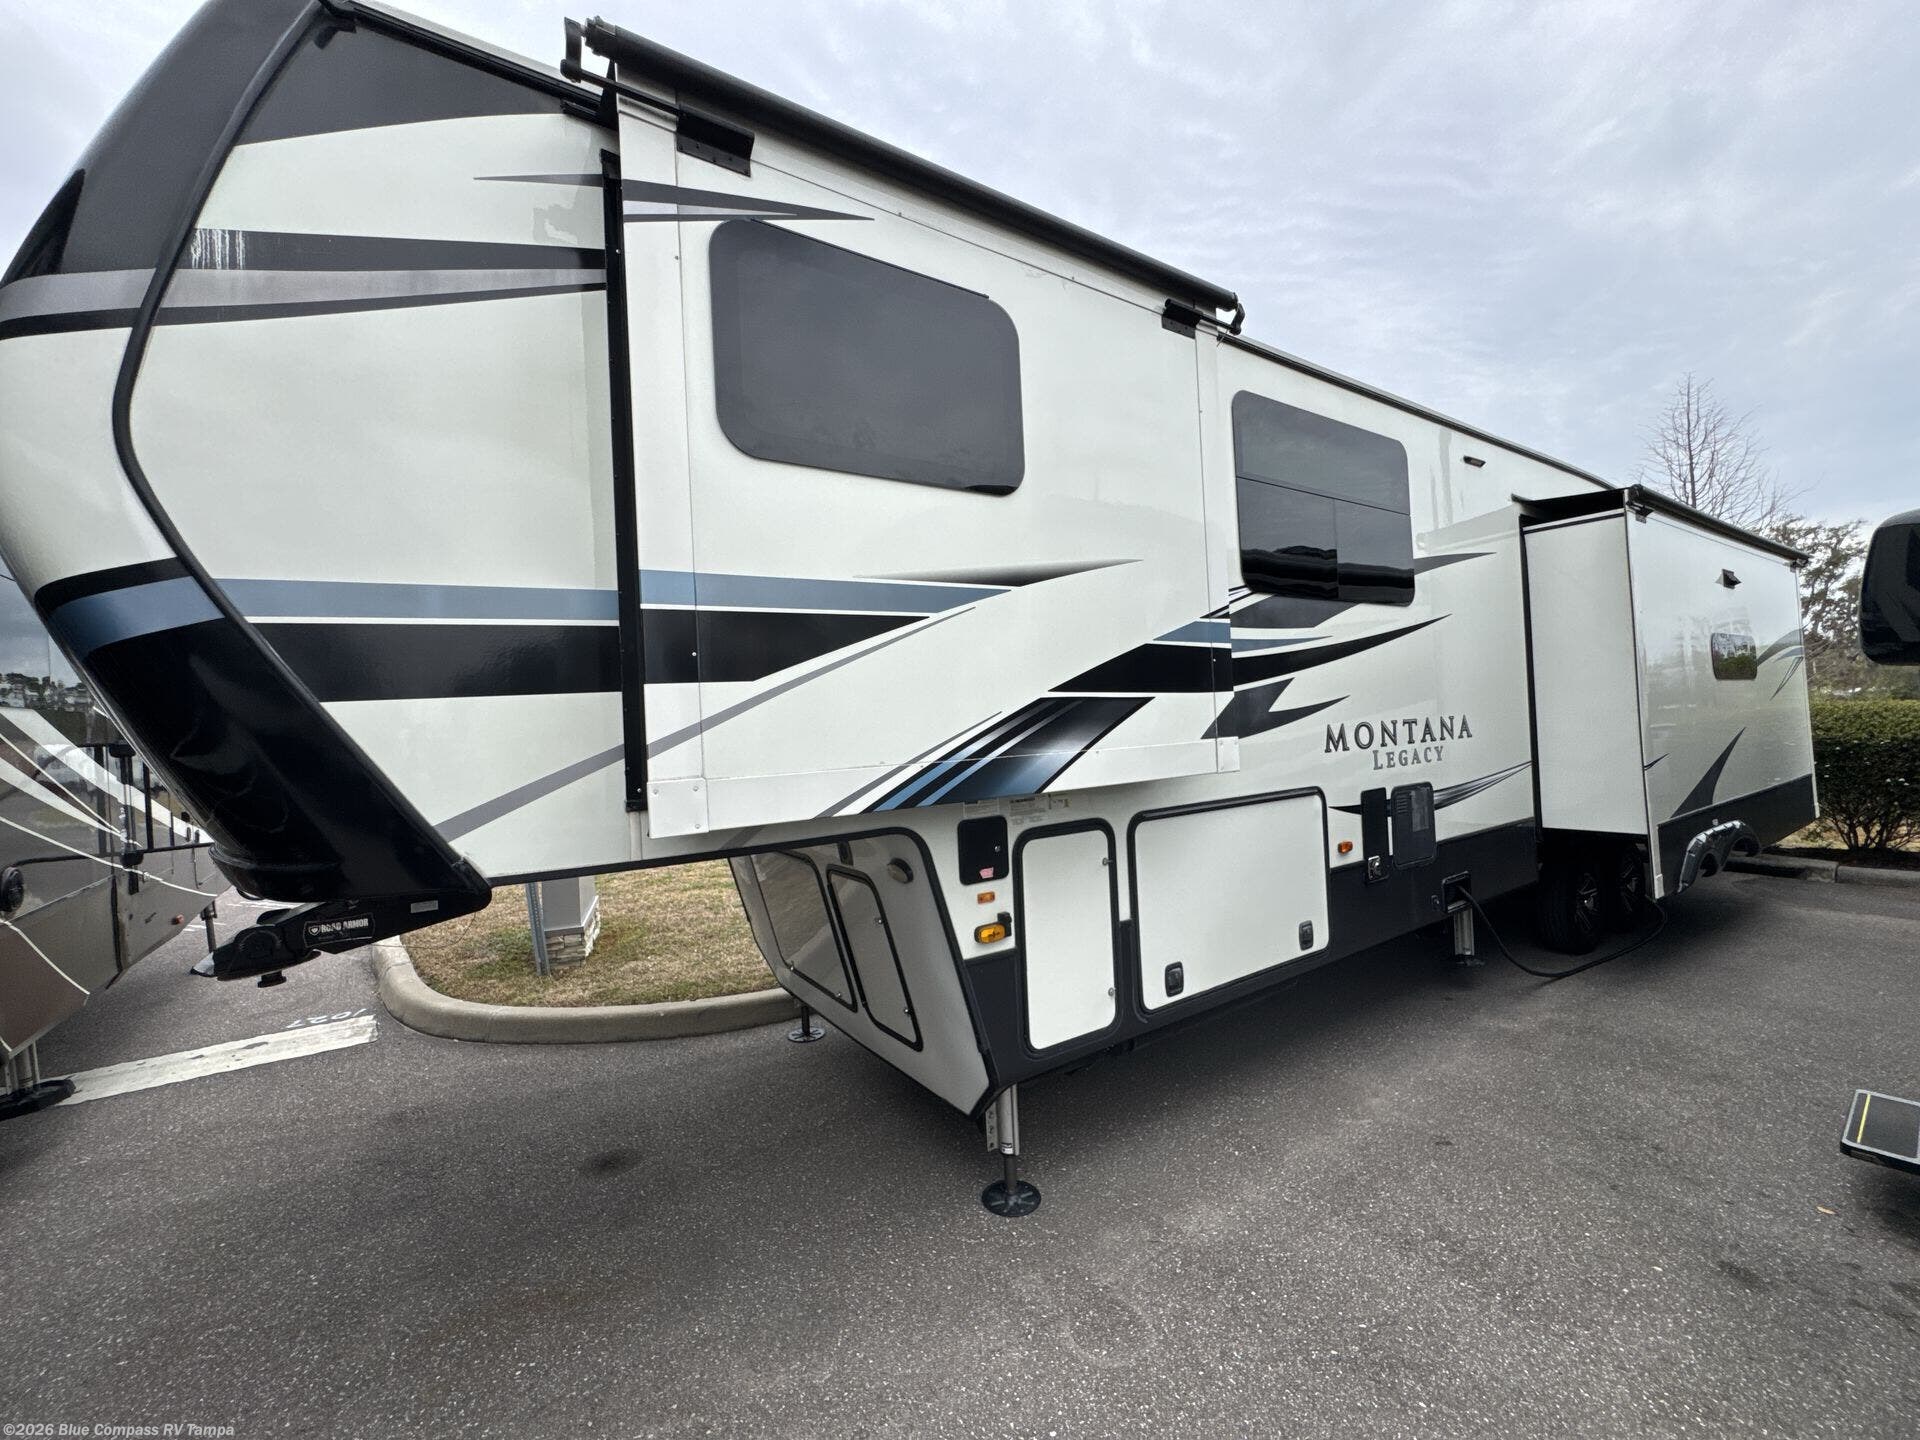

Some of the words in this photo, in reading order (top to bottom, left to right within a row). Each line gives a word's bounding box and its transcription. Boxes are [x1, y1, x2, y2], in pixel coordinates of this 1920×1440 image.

[1324, 714, 1473, 753] MONTANA
[1373, 746, 1444, 770] LEGACY
[321, 921, 342, 933] ROAD
[343, 918, 369, 930] ARMOR
